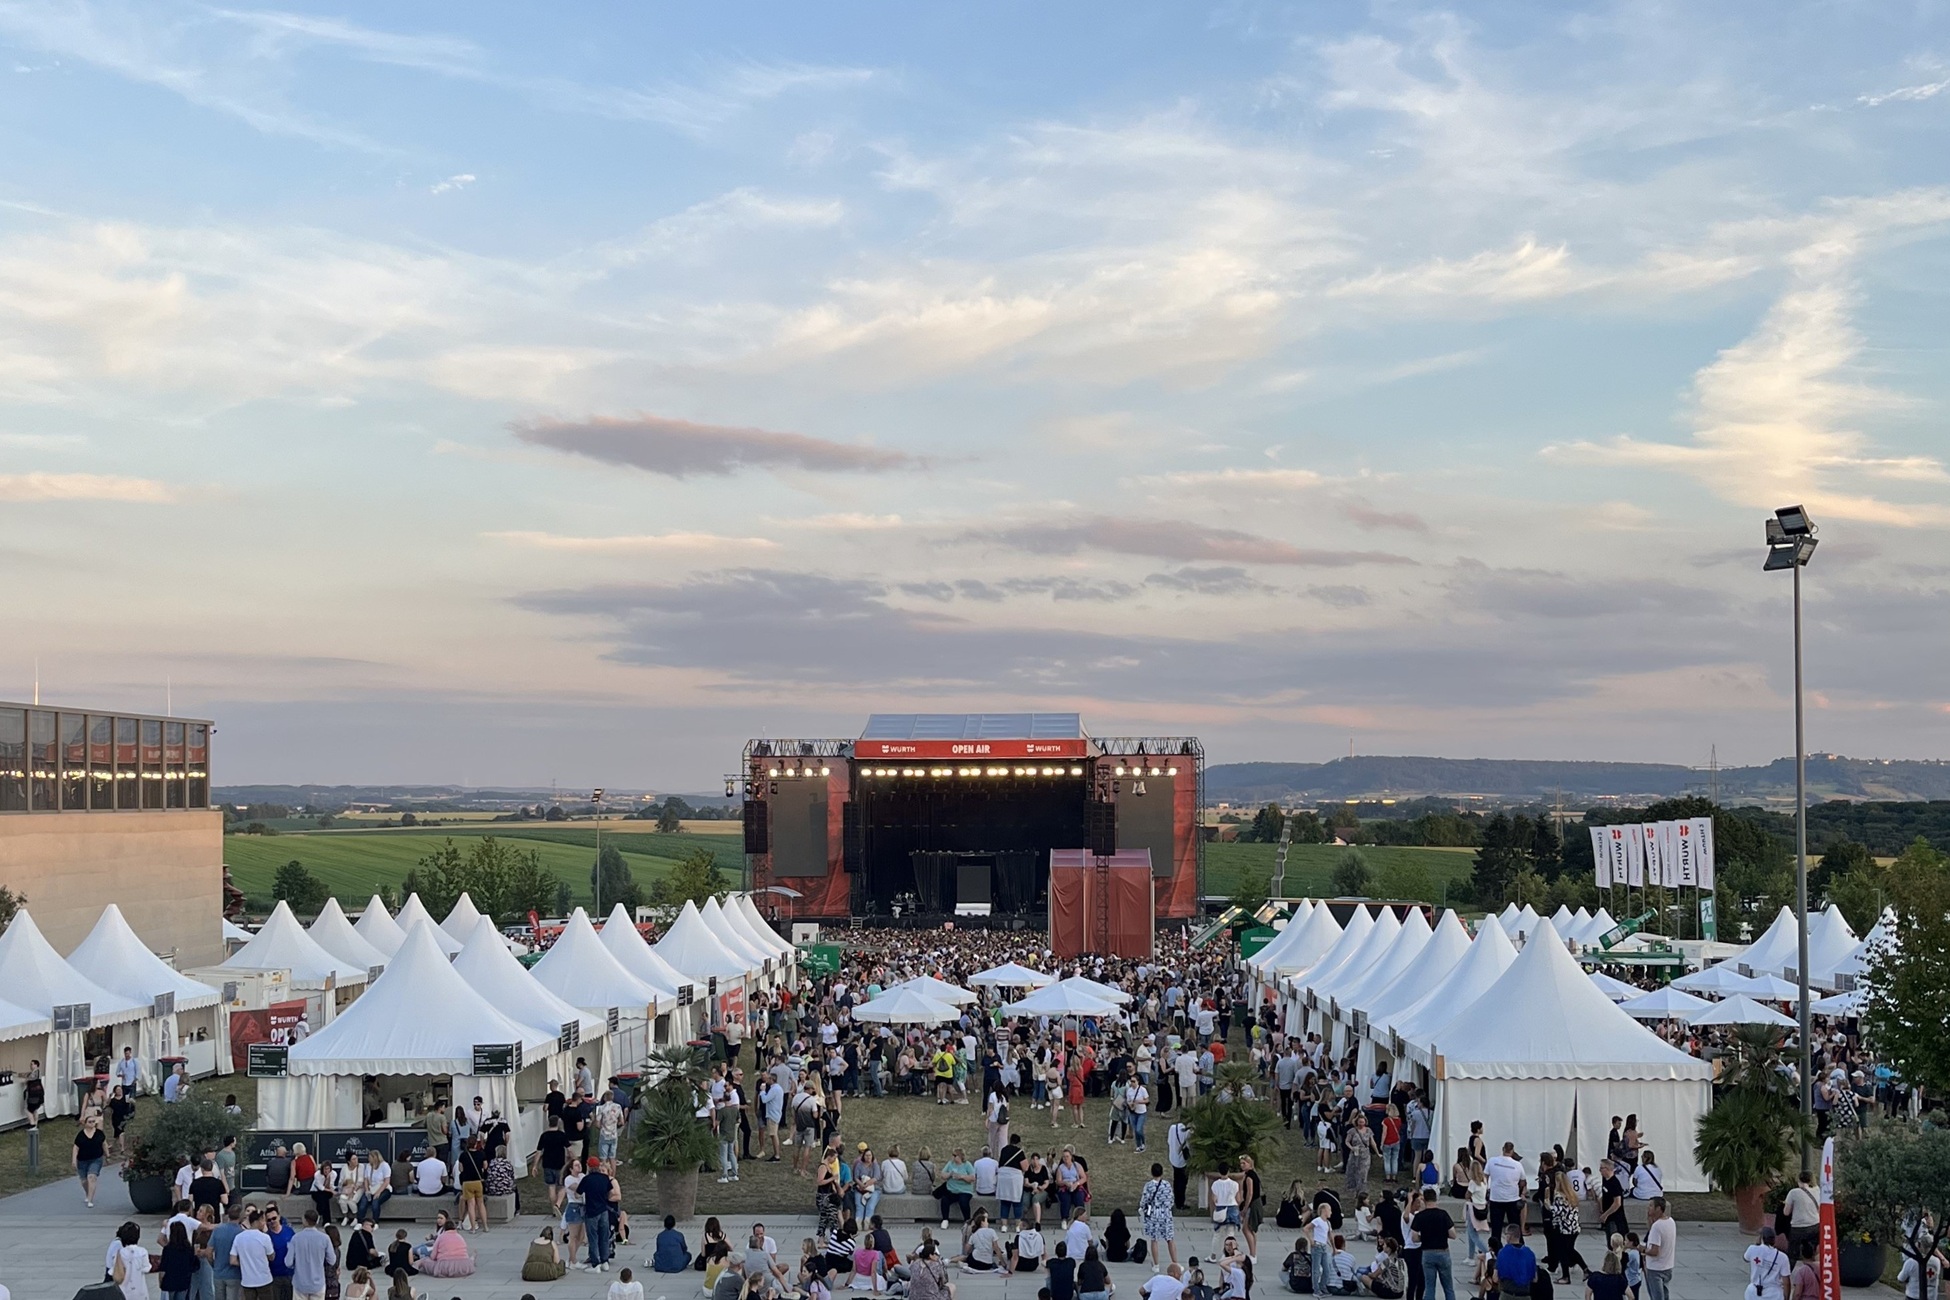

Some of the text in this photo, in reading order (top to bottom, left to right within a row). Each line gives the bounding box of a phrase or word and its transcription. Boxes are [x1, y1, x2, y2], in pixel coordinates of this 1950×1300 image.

[952, 744, 991, 754] OPEN AIR
[1573, 1179, 1580, 1192] 8
